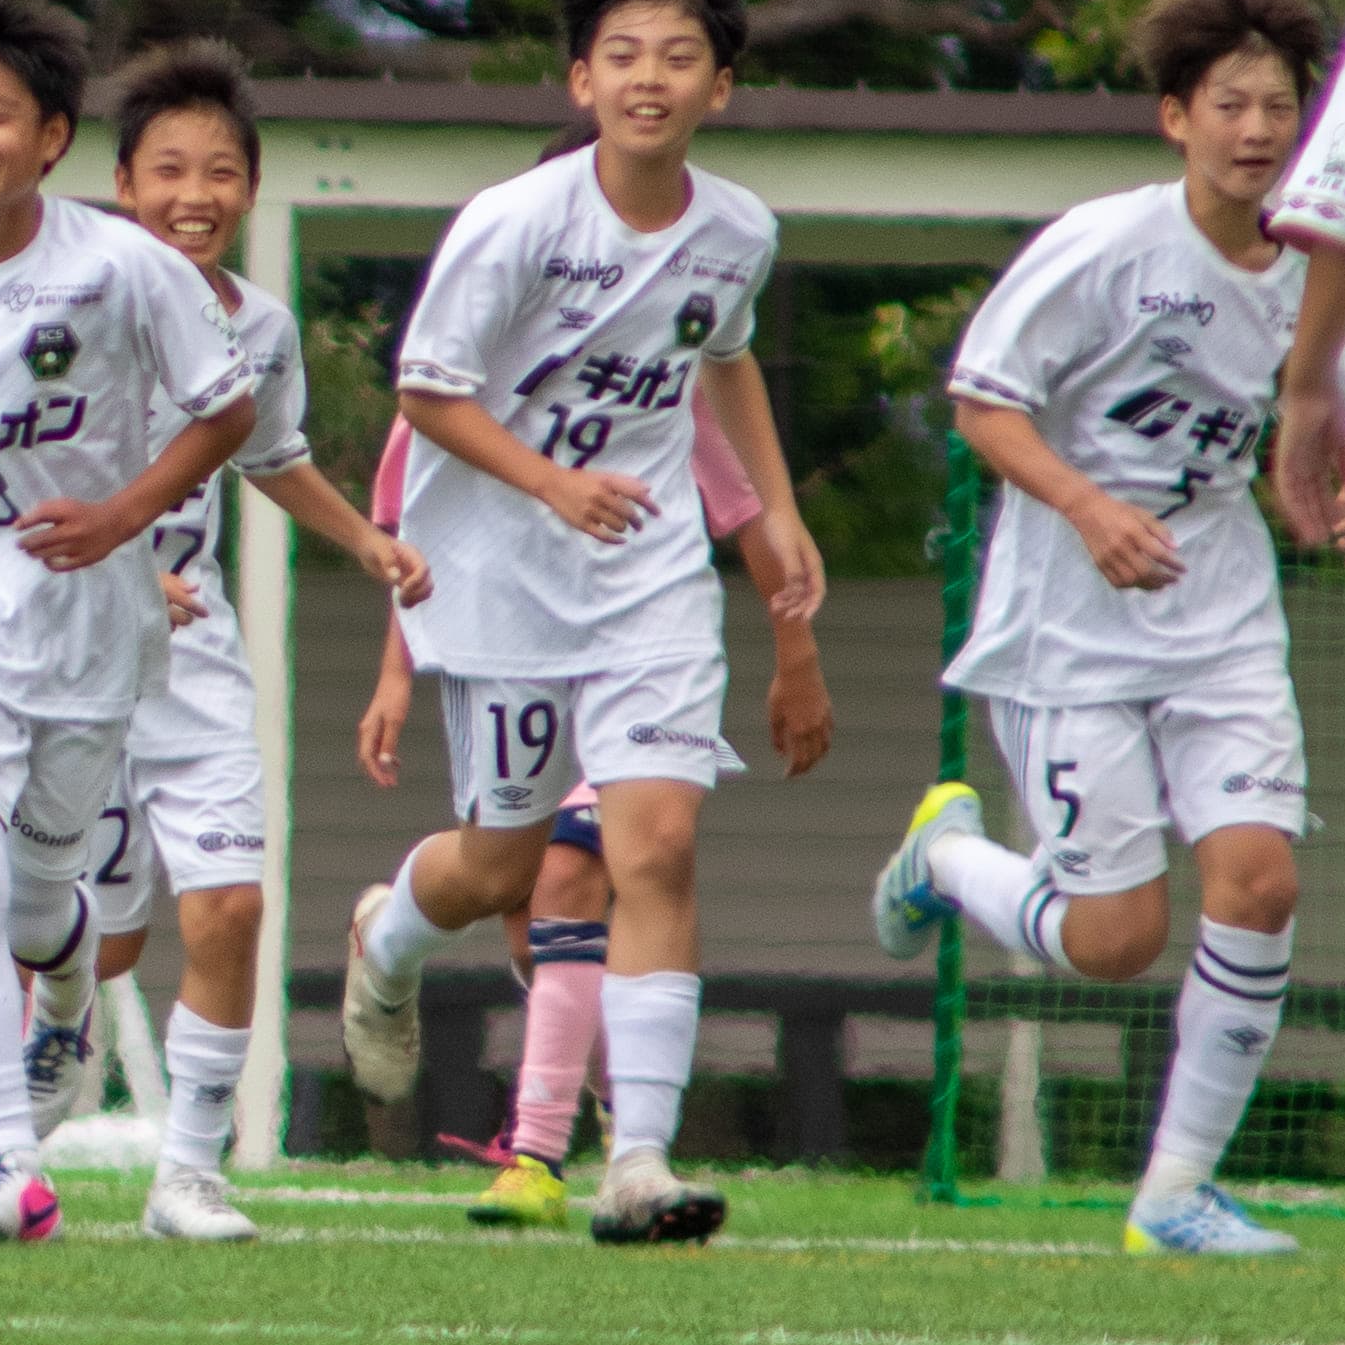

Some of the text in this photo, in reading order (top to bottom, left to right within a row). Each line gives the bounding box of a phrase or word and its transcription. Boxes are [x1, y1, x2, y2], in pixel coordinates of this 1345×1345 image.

[544, 258, 624, 290] Shinko
[541, 402, 613, 469] 19
[487, 699, 558, 780] 19
[1048, 760, 1082, 838] 5
